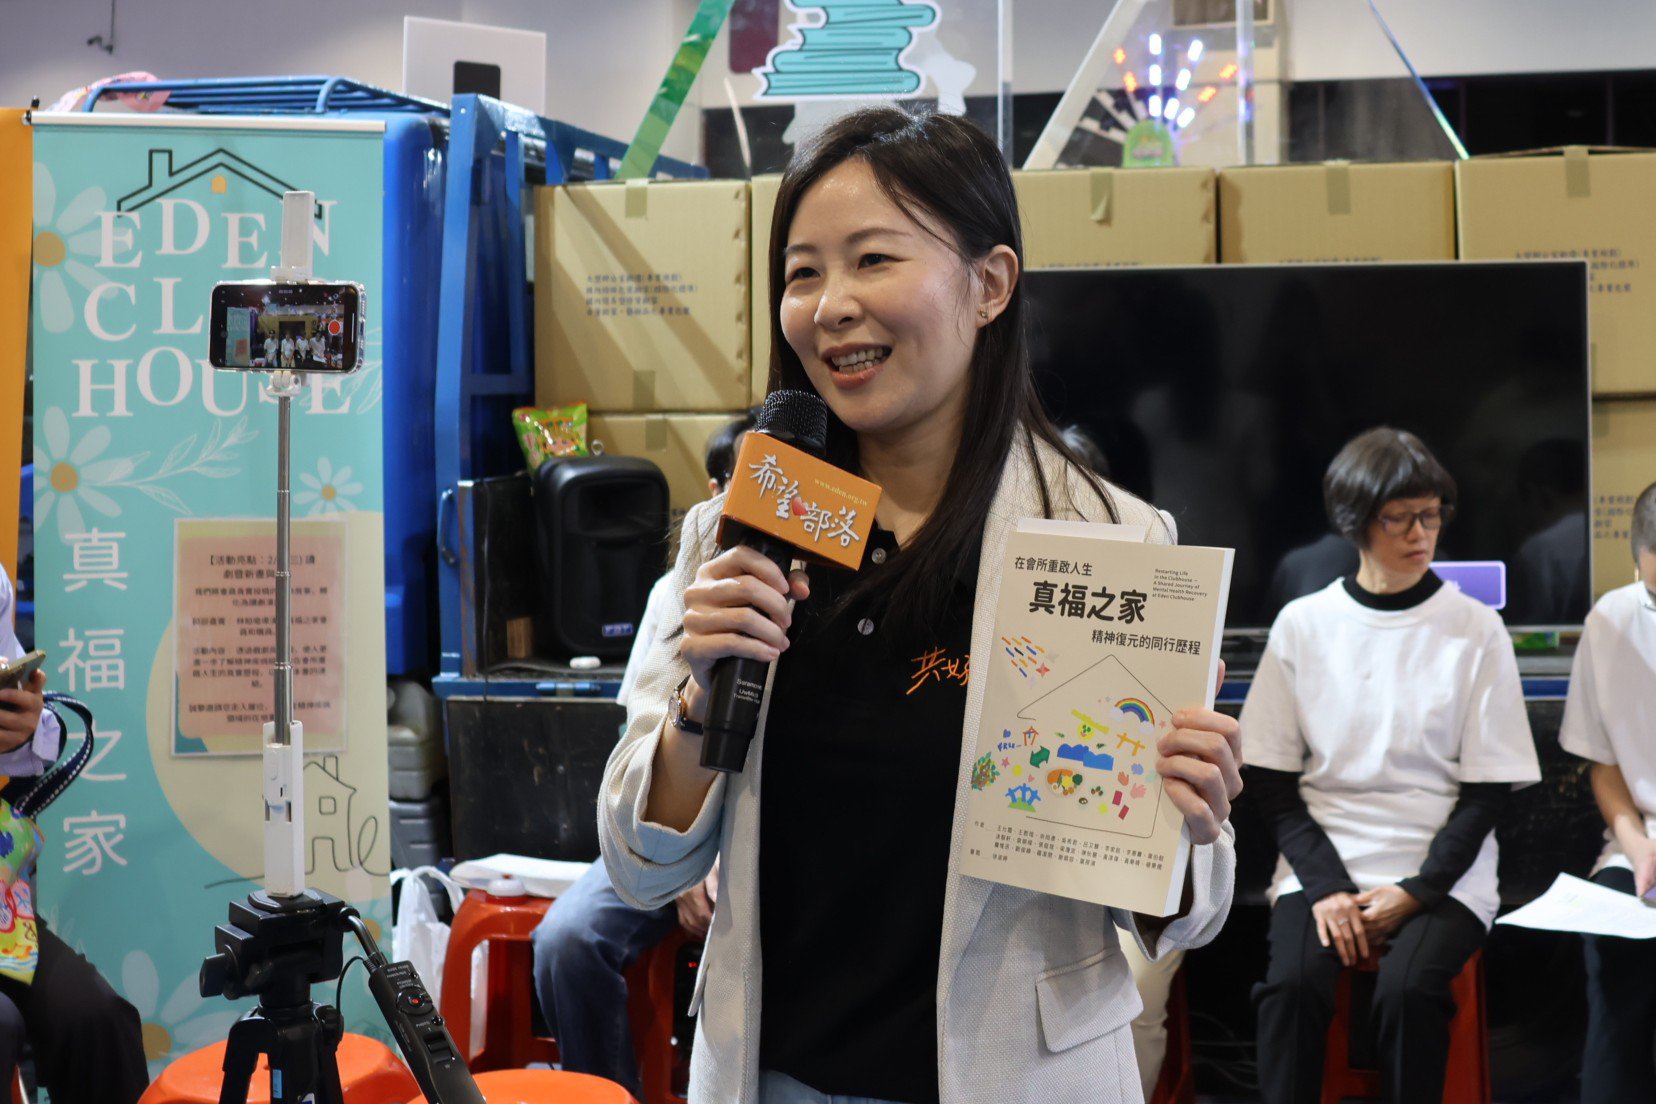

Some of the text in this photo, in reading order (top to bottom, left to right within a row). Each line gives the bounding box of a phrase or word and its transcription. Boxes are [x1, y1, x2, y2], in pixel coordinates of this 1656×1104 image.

[814, 476, 869, 508] www.eden.org.tw
[1014, 556, 1093, 577] 在會所重啟人生
[1174, 582, 1194, 590] Journey
[1028, 580, 1148, 625] 真福之家
[1091, 629, 1201, 656] 精神復元的同行歷程
